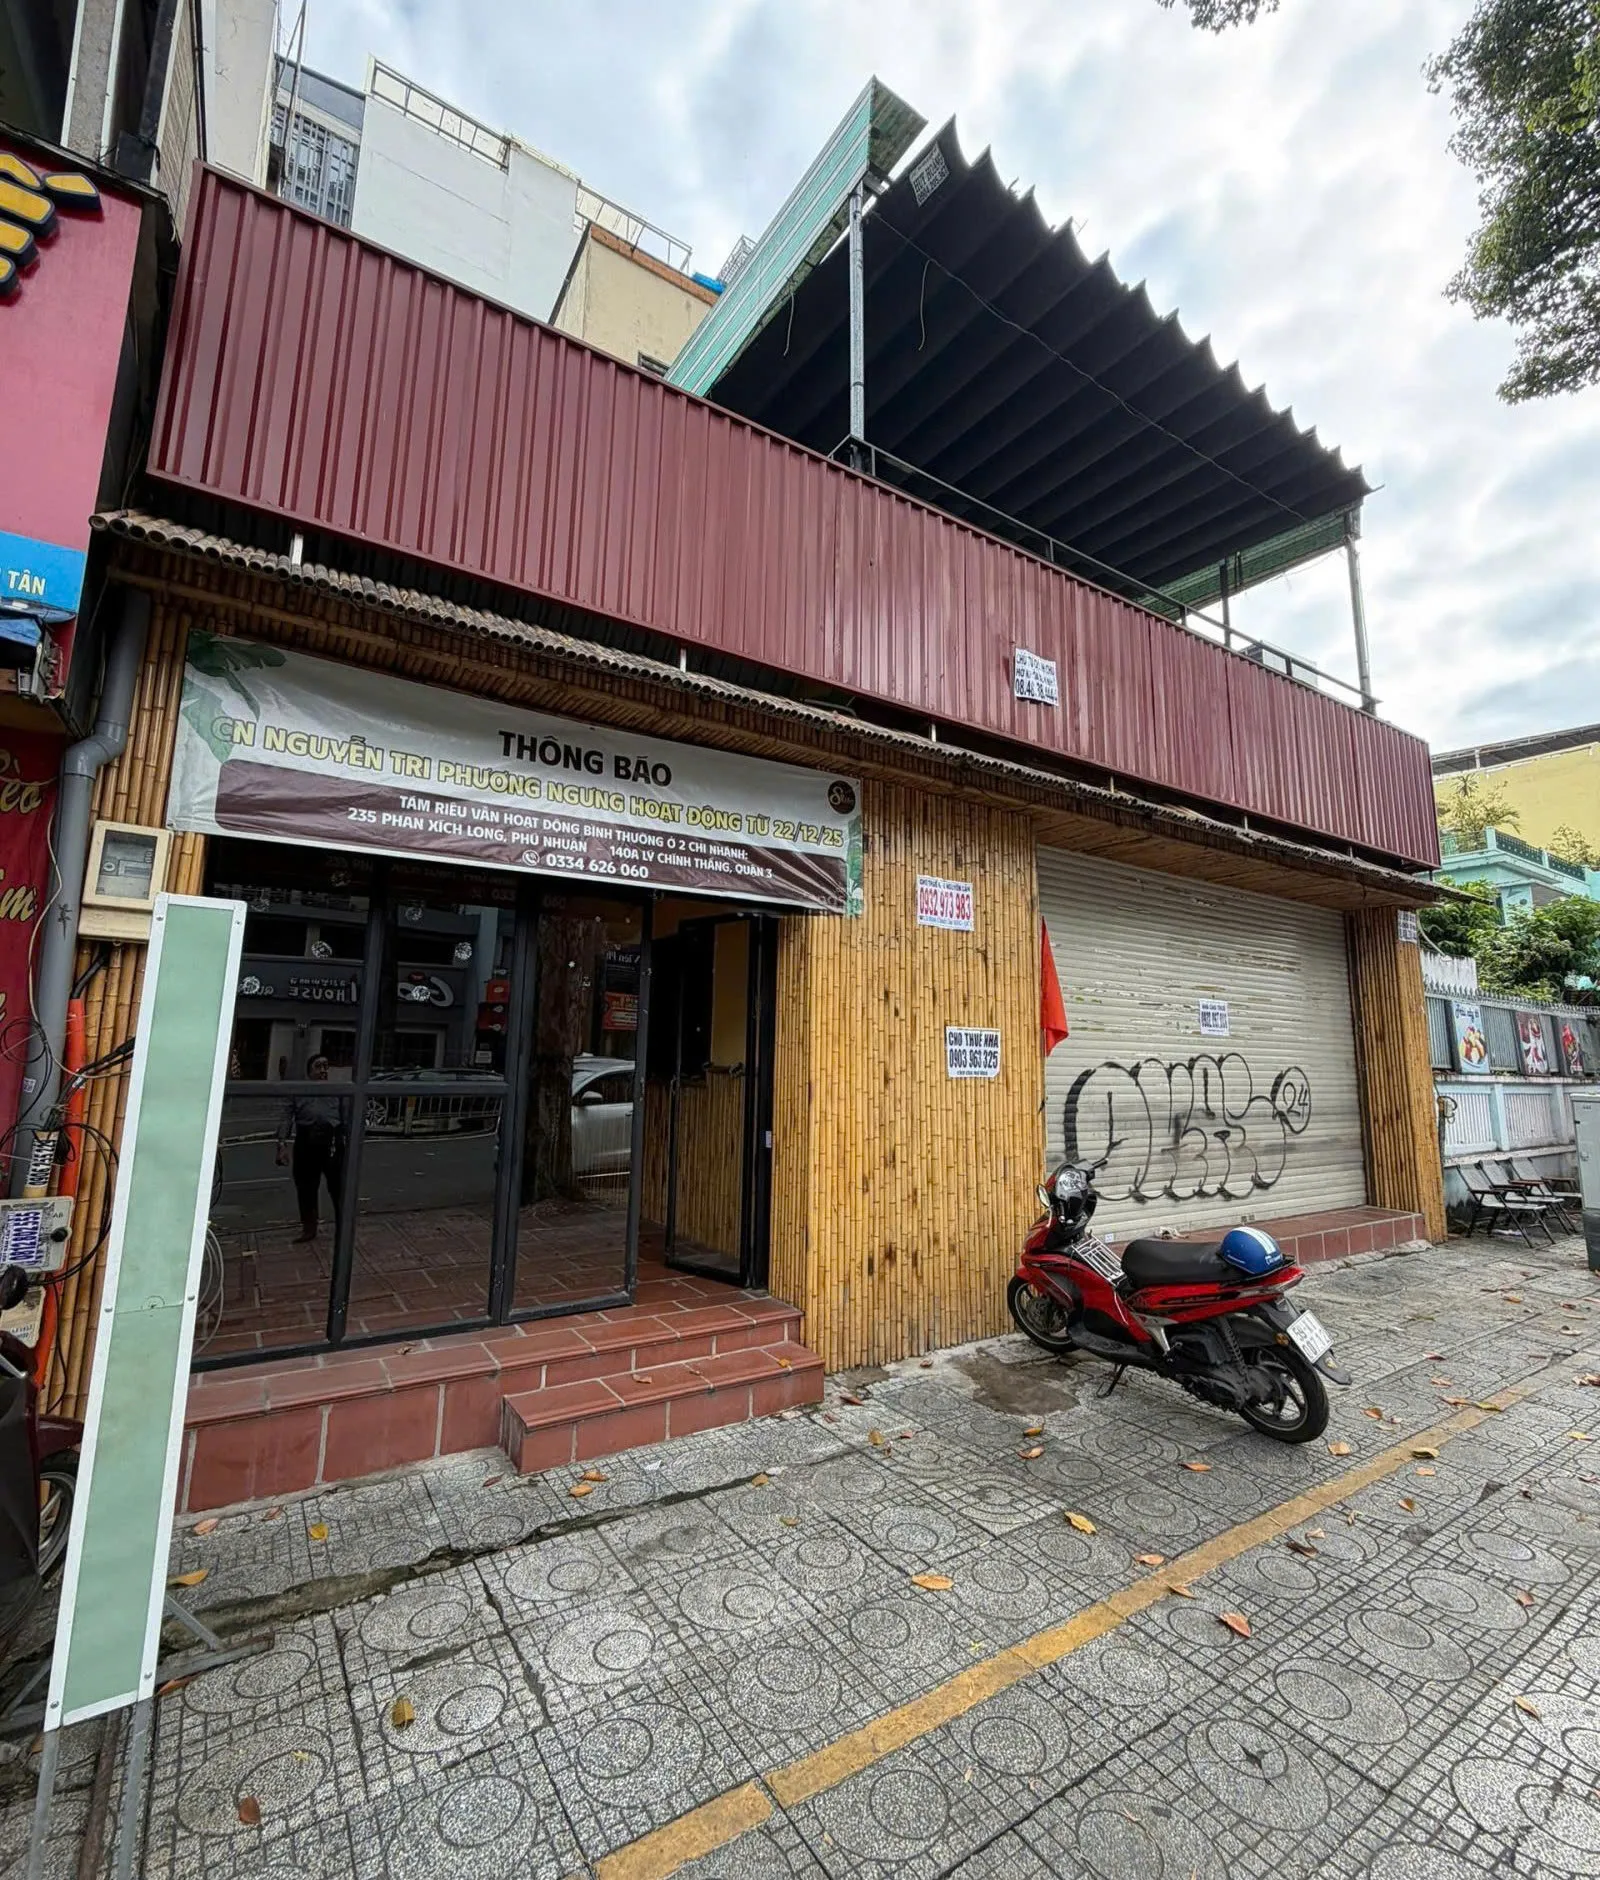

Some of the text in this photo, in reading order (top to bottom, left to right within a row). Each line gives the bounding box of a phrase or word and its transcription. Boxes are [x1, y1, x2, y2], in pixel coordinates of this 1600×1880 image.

[8, 569, 46, 596] TÂN
[498, 730, 604, 775] THÔNG
[211, 716, 256, 747] CN
[263, 725, 385, 771] NGUYỄN
[389, 750, 432, 780] TRI
[437, 759, 542, 799] PHƯƠNG
[630, 796, 684, 823] HOẠT
[686, 805, 742, 832] ĐỘNG
[746, 813, 770, 836] TỪ
[773, 820, 844, 847] 22/12/25
[347, 807, 377, 823] 235
[382, 812, 424, 830] PHAN
[428, 818, 463, 836] XÍCH
[399, 795, 430, 813] TÁM
[583, 823, 613, 840] BÌNH
[679, 840, 686, 850] 2
[688, 841, 707, 854] CHI
[546, 853, 649, 879] 0334 626 060
[610, 845, 640, 860] 140A
[657, 852, 692, 867] CHÍNH
[766, 868, 773, 879] 3
[919, 887, 971, 920] 0932 973 983
[948, 1031, 963, 1046] CHO
[949, 1048, 968, 1068] 0903
[983, 1049, 998, 1069] 325
